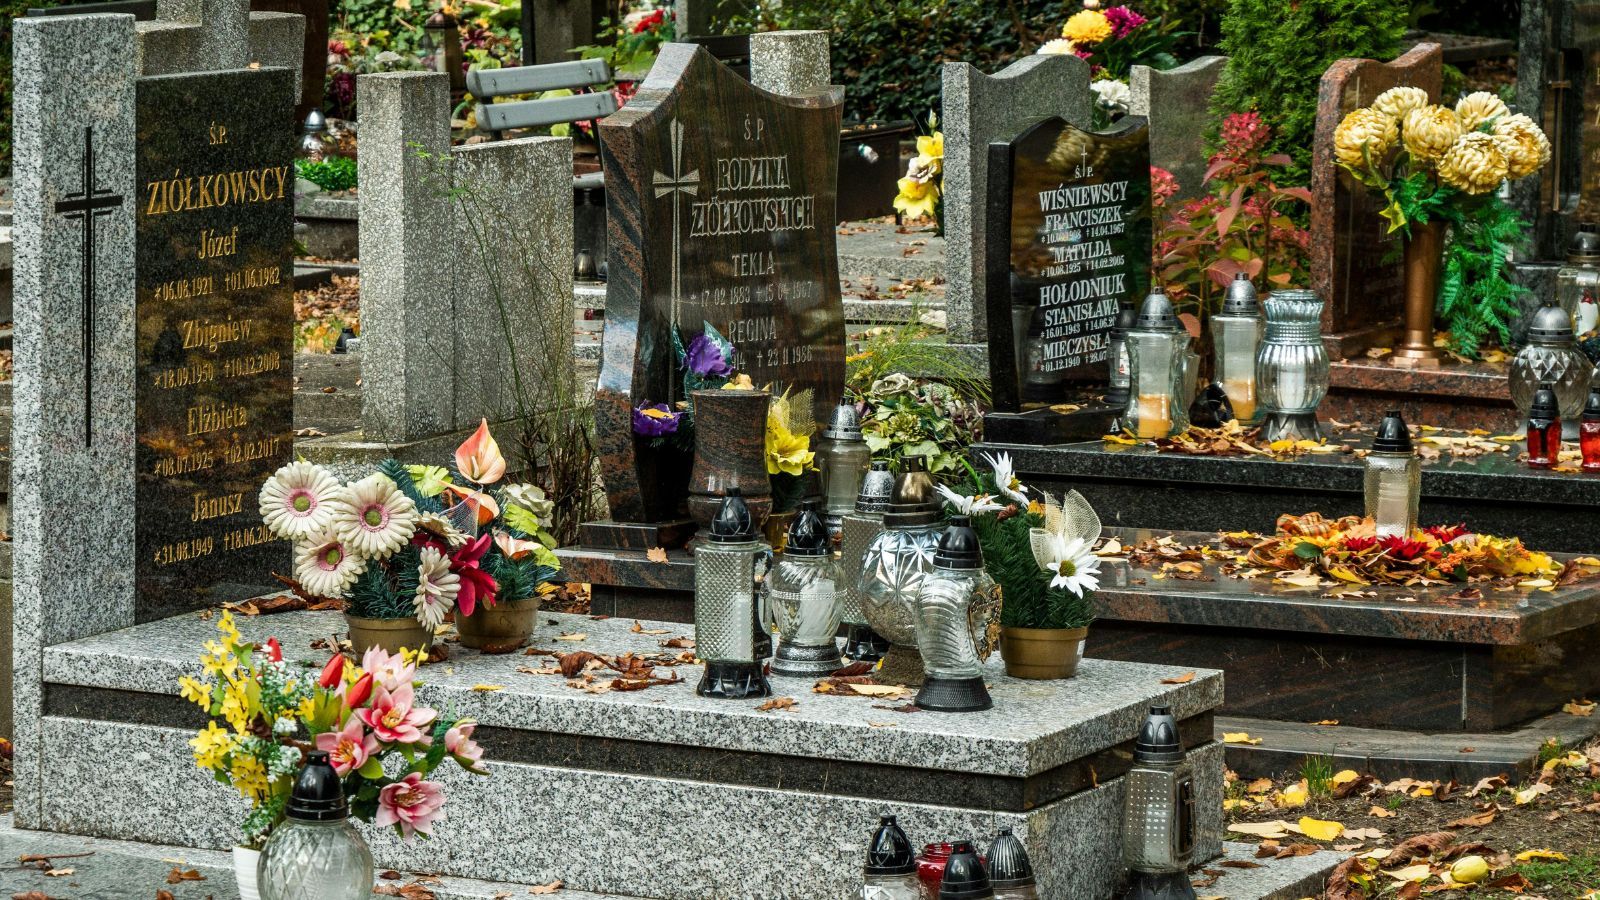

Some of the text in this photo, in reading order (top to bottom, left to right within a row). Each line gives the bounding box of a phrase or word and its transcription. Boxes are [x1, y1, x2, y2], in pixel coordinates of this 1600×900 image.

[716, 155, 791, 192] RODZINA
[146, 166, 289, 215] ZIÓŁKOWSCY
[1038, 180, 1129, 212] WIŚNIEWSCY
[689, 194, 816, 238] ZIÓŁKOWSKICH
[1045, 205, 1122, 232] FRANCISZEK
[198, 226, 239, 260] Józef
[1054, 239, 1113, 264] MATYLDA
[731, 251, 776, 277] TEKLA
[1039, 273, 1126, 307] HOŁODNIUK
[1044, 298, 1120, 327] STANISŁAWA
[183, 315, 252, 352] Zbigniew
[728, 316, 777, 344] REGINA
[186, 402, 247, 436] Elżbieta
[191, 493, 243, 522] Janusz
